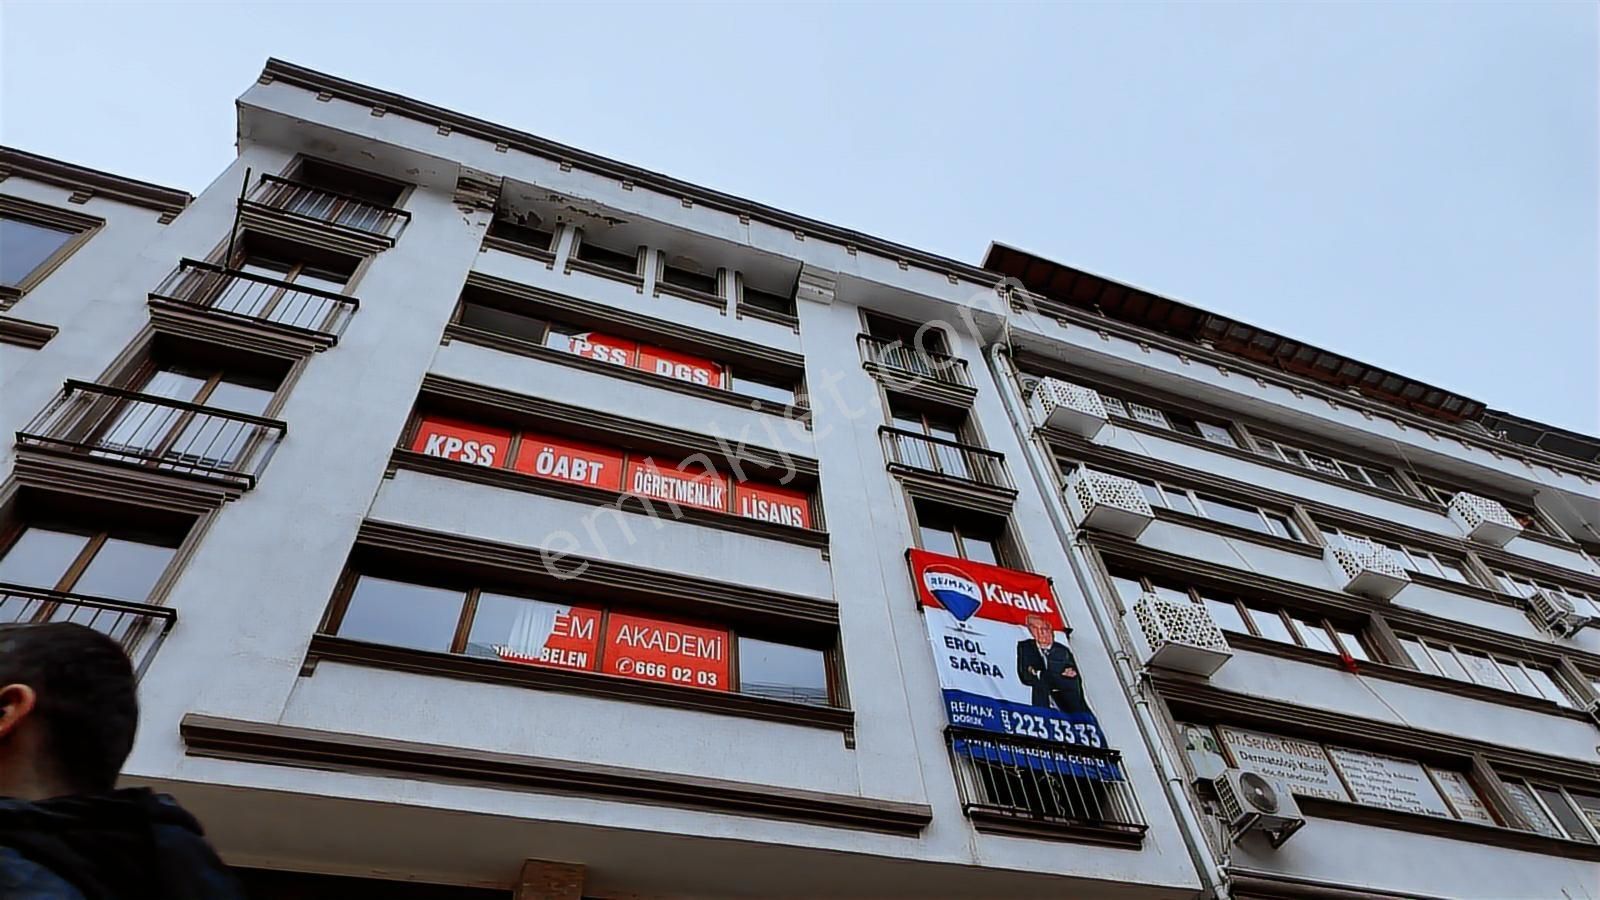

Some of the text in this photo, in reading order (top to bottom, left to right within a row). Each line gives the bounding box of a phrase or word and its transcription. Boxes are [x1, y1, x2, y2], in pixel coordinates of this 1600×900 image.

[656, 358, 709, 386] DGS
[423, 433, 496, 467] KPSS
[536, 446, 604, 484] ÖABT
[634, 467, 723, 509] ÖĞRETMENLİK
[742, 494, 803, 528] LİSANS
[983, 582, 1053, 613] Kiralık
[540, 647, 588, 668] BELEN
[616, 623, 722, 661] AKADEMİ
[944, 635, 986, 656] EROL
[635, 662, 718, 686] 666 02 03
[949, 655, 1004, 679] SAĞRA
[1012, 712, 1048, 739] 223
[1050, 719, 1075, 744] 33
[1075, 723, 1101, 747] 33
